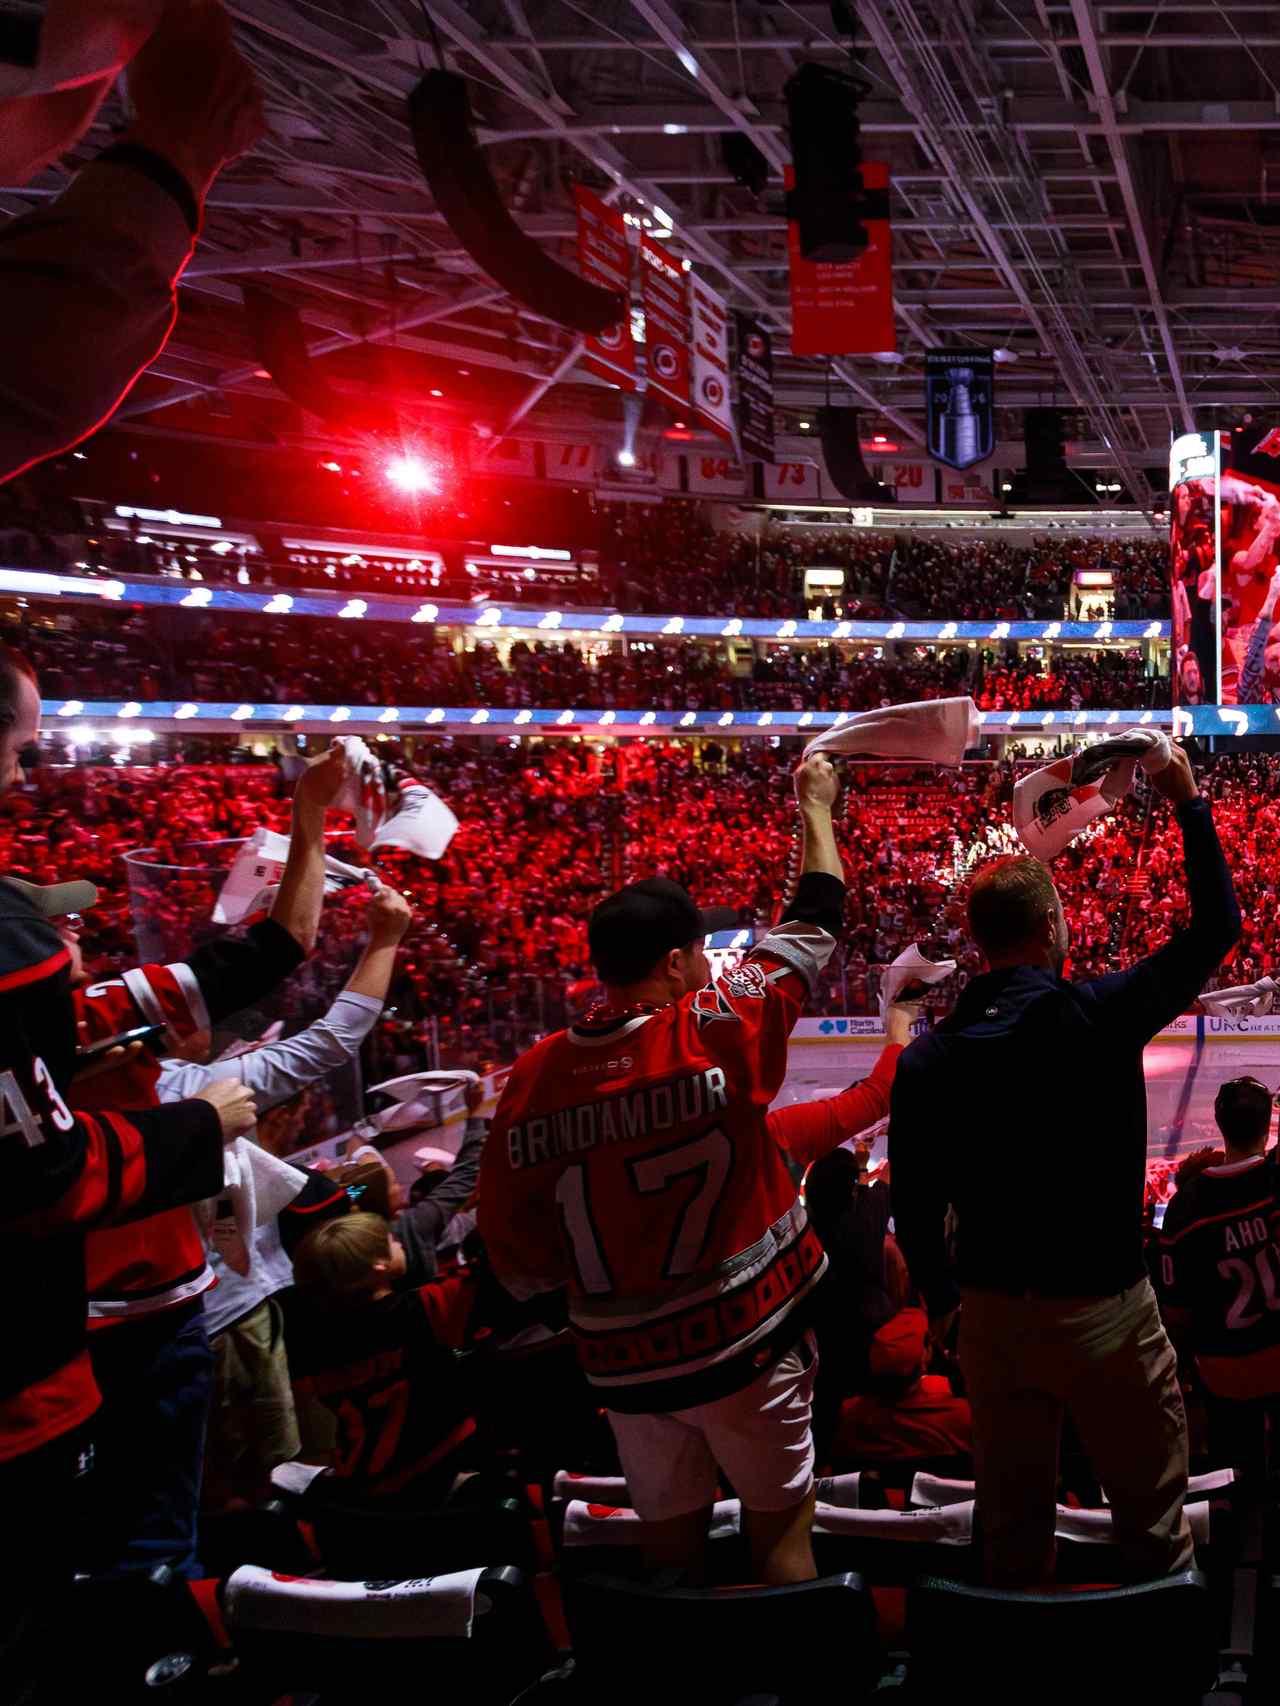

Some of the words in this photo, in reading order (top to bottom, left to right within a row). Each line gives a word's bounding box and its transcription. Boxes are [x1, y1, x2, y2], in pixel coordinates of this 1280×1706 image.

[1209, 1019, 1249, 1032] UNC
[554, 1127, 736, 1297] 17
[1222, 1216, 1269, 1257] AHO
